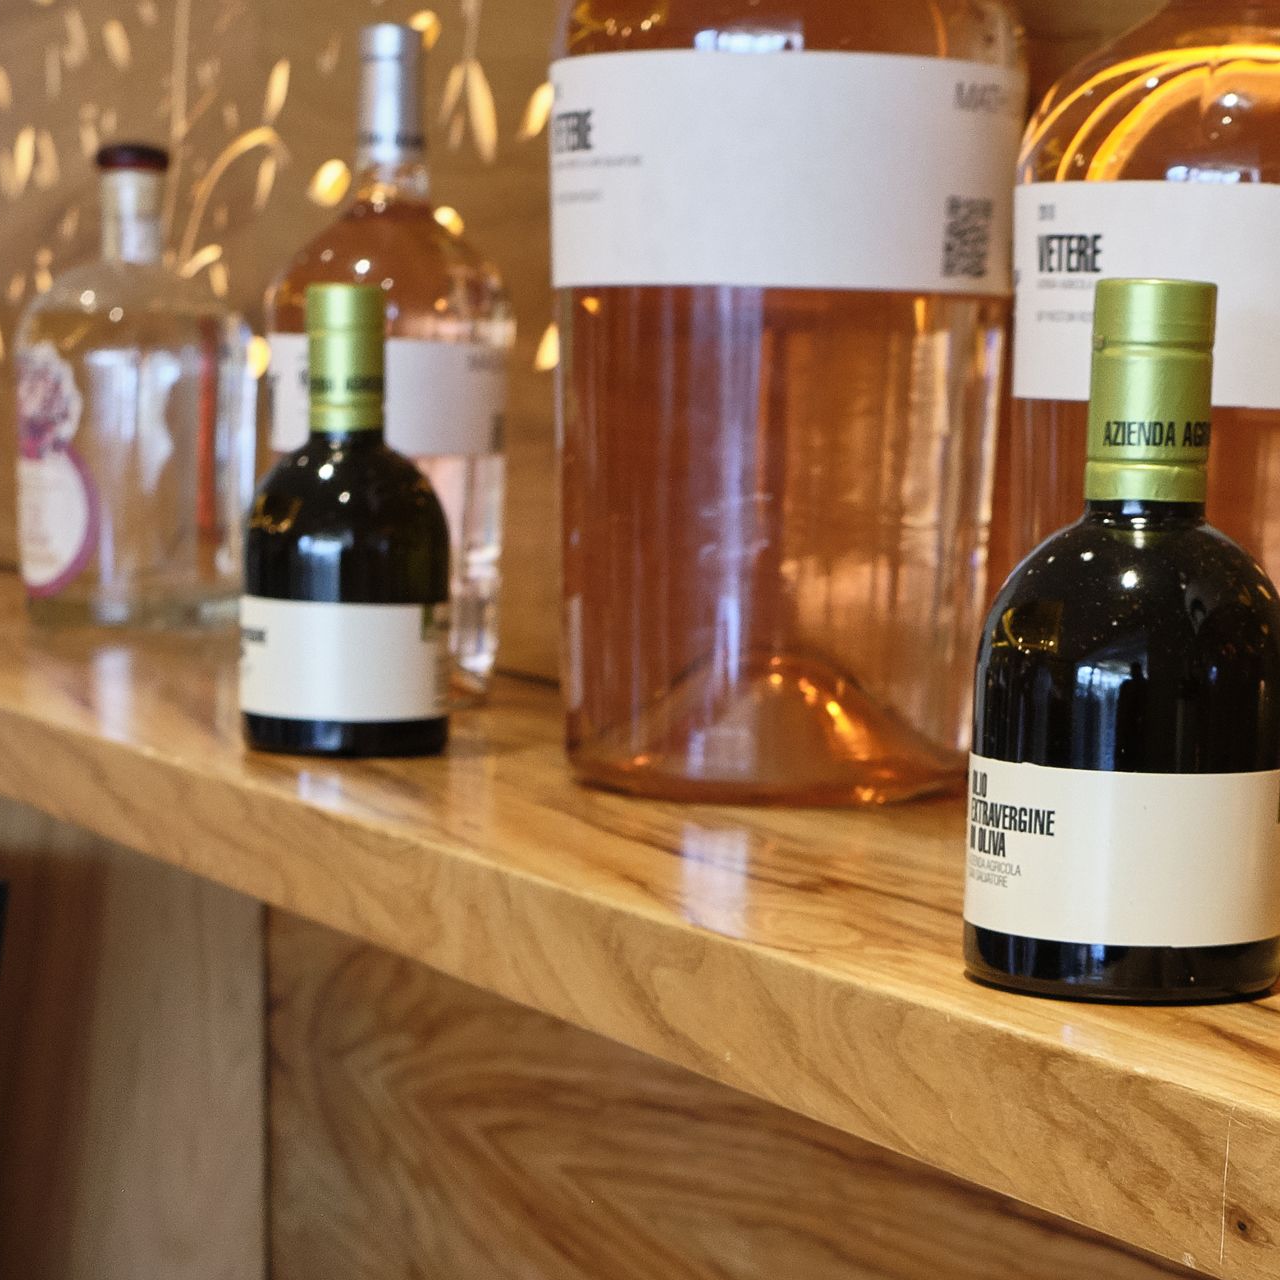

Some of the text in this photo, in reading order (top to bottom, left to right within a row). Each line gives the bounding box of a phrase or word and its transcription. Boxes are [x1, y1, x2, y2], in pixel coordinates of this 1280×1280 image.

[1038, 234, 1102, 273] VETERE
[1102, 420, 1176, 447] AZIENDA
[971, 798, 1056, 836] EXTRAVERGINE
[978, 828, 1006, 857] OLIVA
